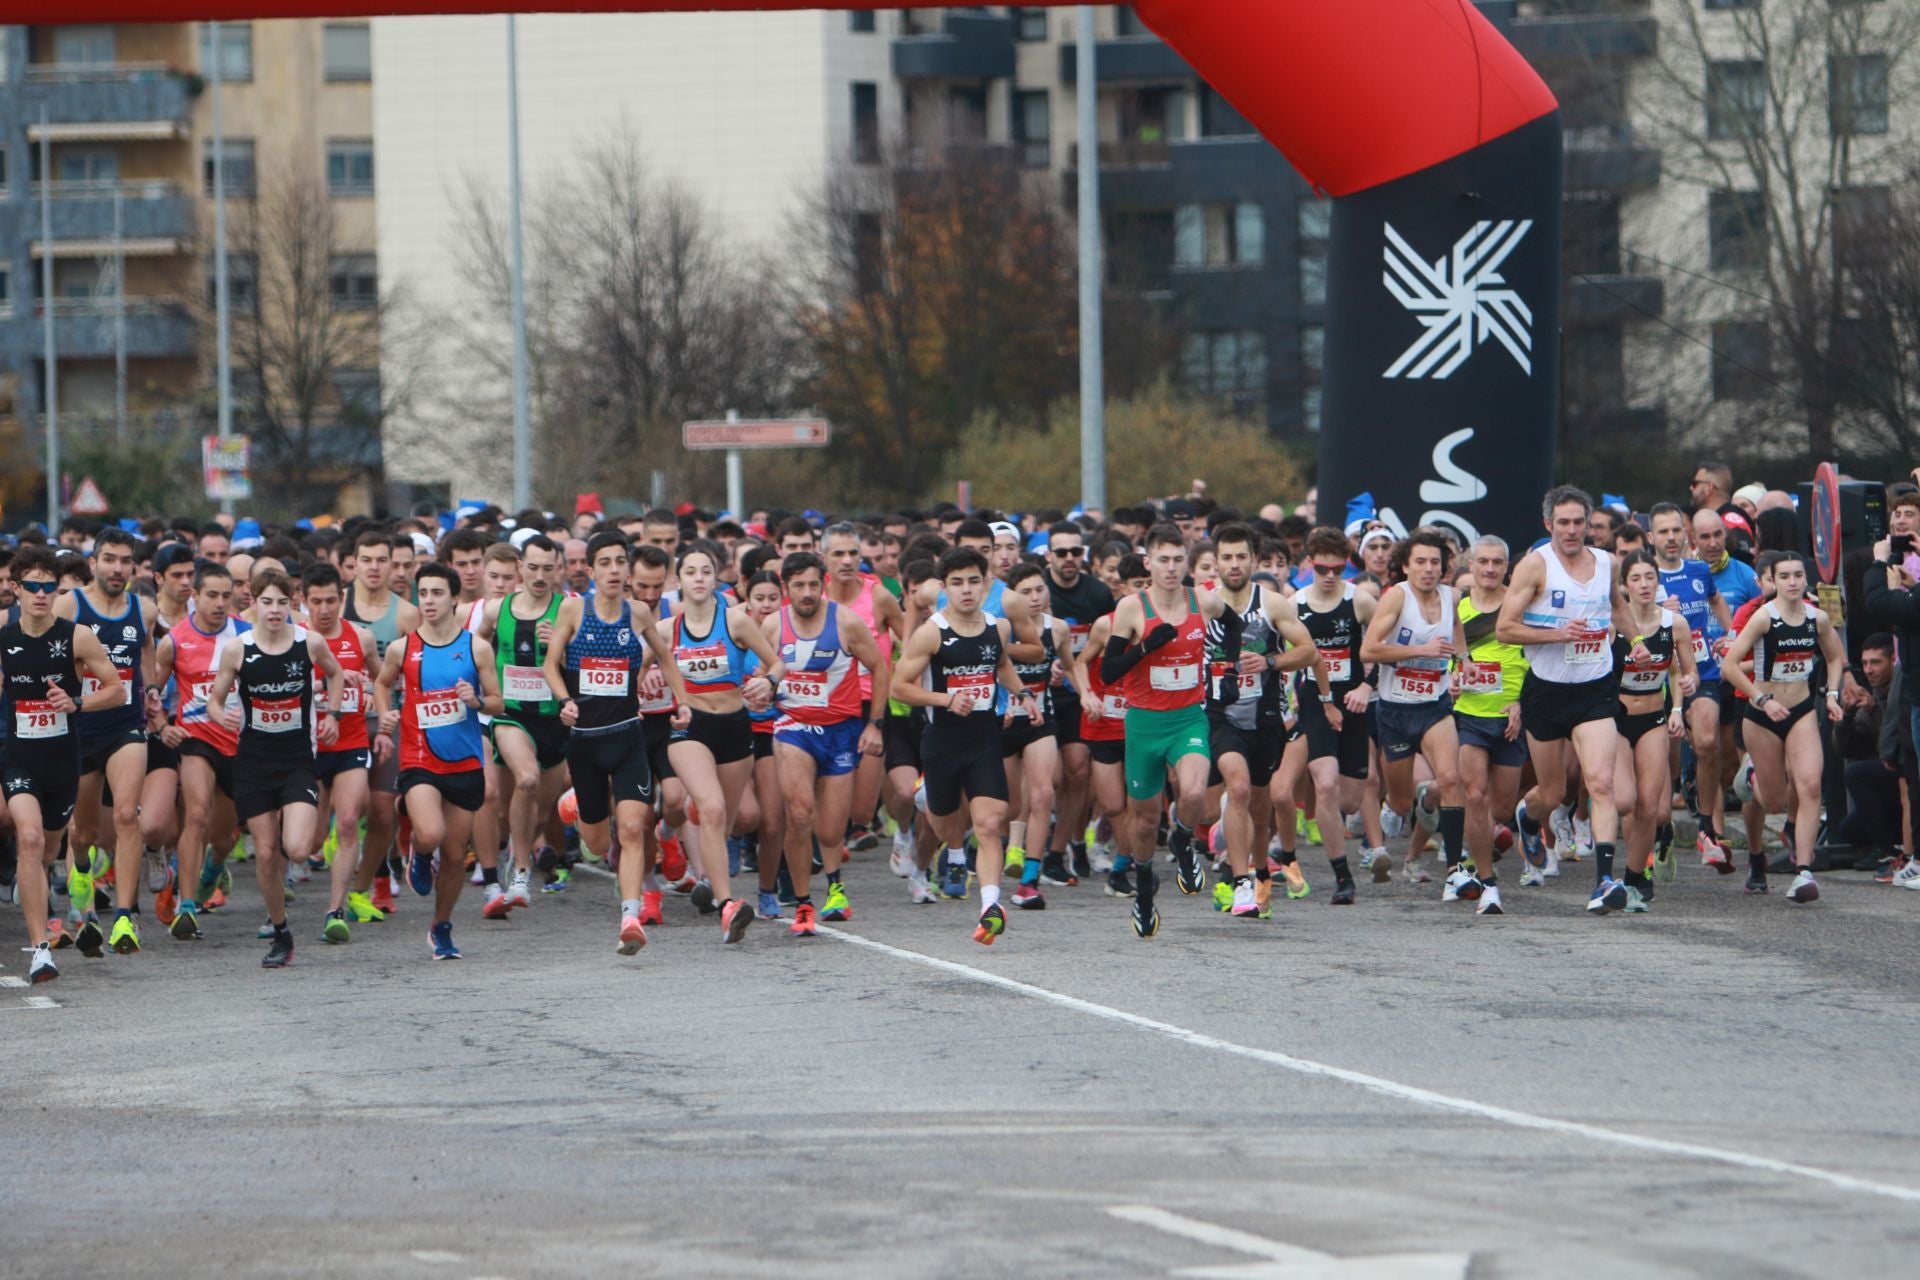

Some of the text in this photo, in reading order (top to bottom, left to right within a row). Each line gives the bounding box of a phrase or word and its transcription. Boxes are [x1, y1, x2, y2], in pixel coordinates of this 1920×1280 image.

[1574, 642, 1601, 655] 1172
[1778, 637, 1815, 647] WOLVES
[111, 655, 132, 666] Vardy
[688, 659, 719, 673] 204
[1173, 668, 1180, 680] 1
[1782, 662, 1806, 674] 262
[586, 671, 624, 685] 1028
[1633, 672, 1660, 682] 457
[247, 680, 305, 693] WOLVES
[511, 679, 543, 689] 2028
[786, 682, 821, 697] 1963
[1400, 679, 1434, 695] 1554
[423, 701, 460, 718] 1031
[28, 713, 57, 728] 781
[261, 711, 292, 724] 890
